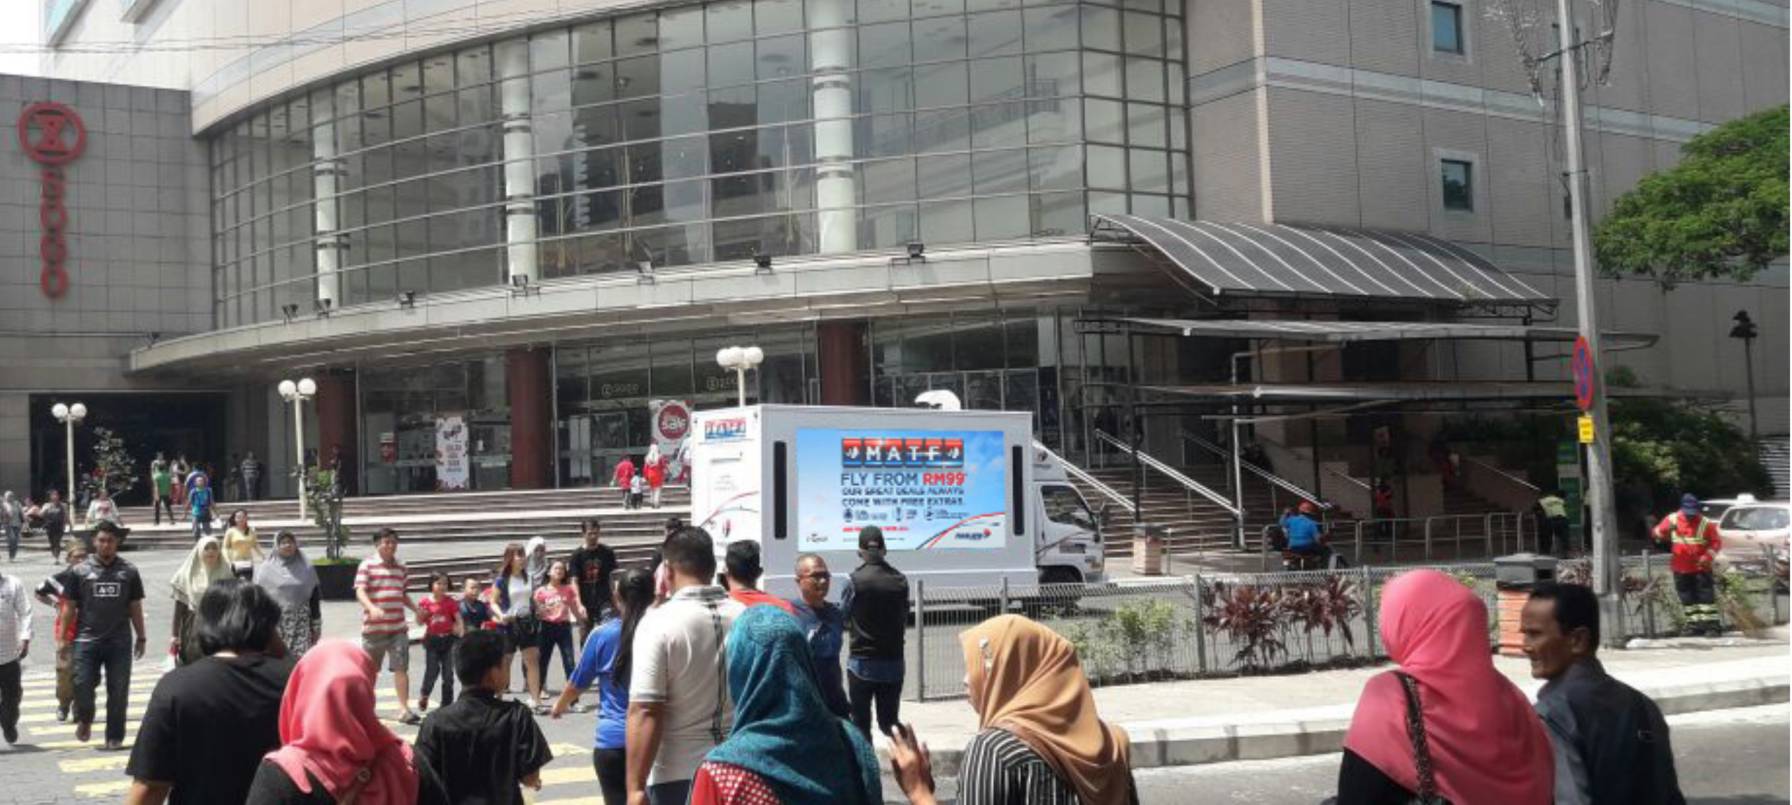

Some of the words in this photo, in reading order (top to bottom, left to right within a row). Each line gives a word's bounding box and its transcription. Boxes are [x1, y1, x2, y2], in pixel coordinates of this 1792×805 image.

[866, 445, 941, 461] MATF
[840, 472, 867, 486] FLY
[874, 472, 919, 486] FROM
[841, 498, 870, 507] COME
